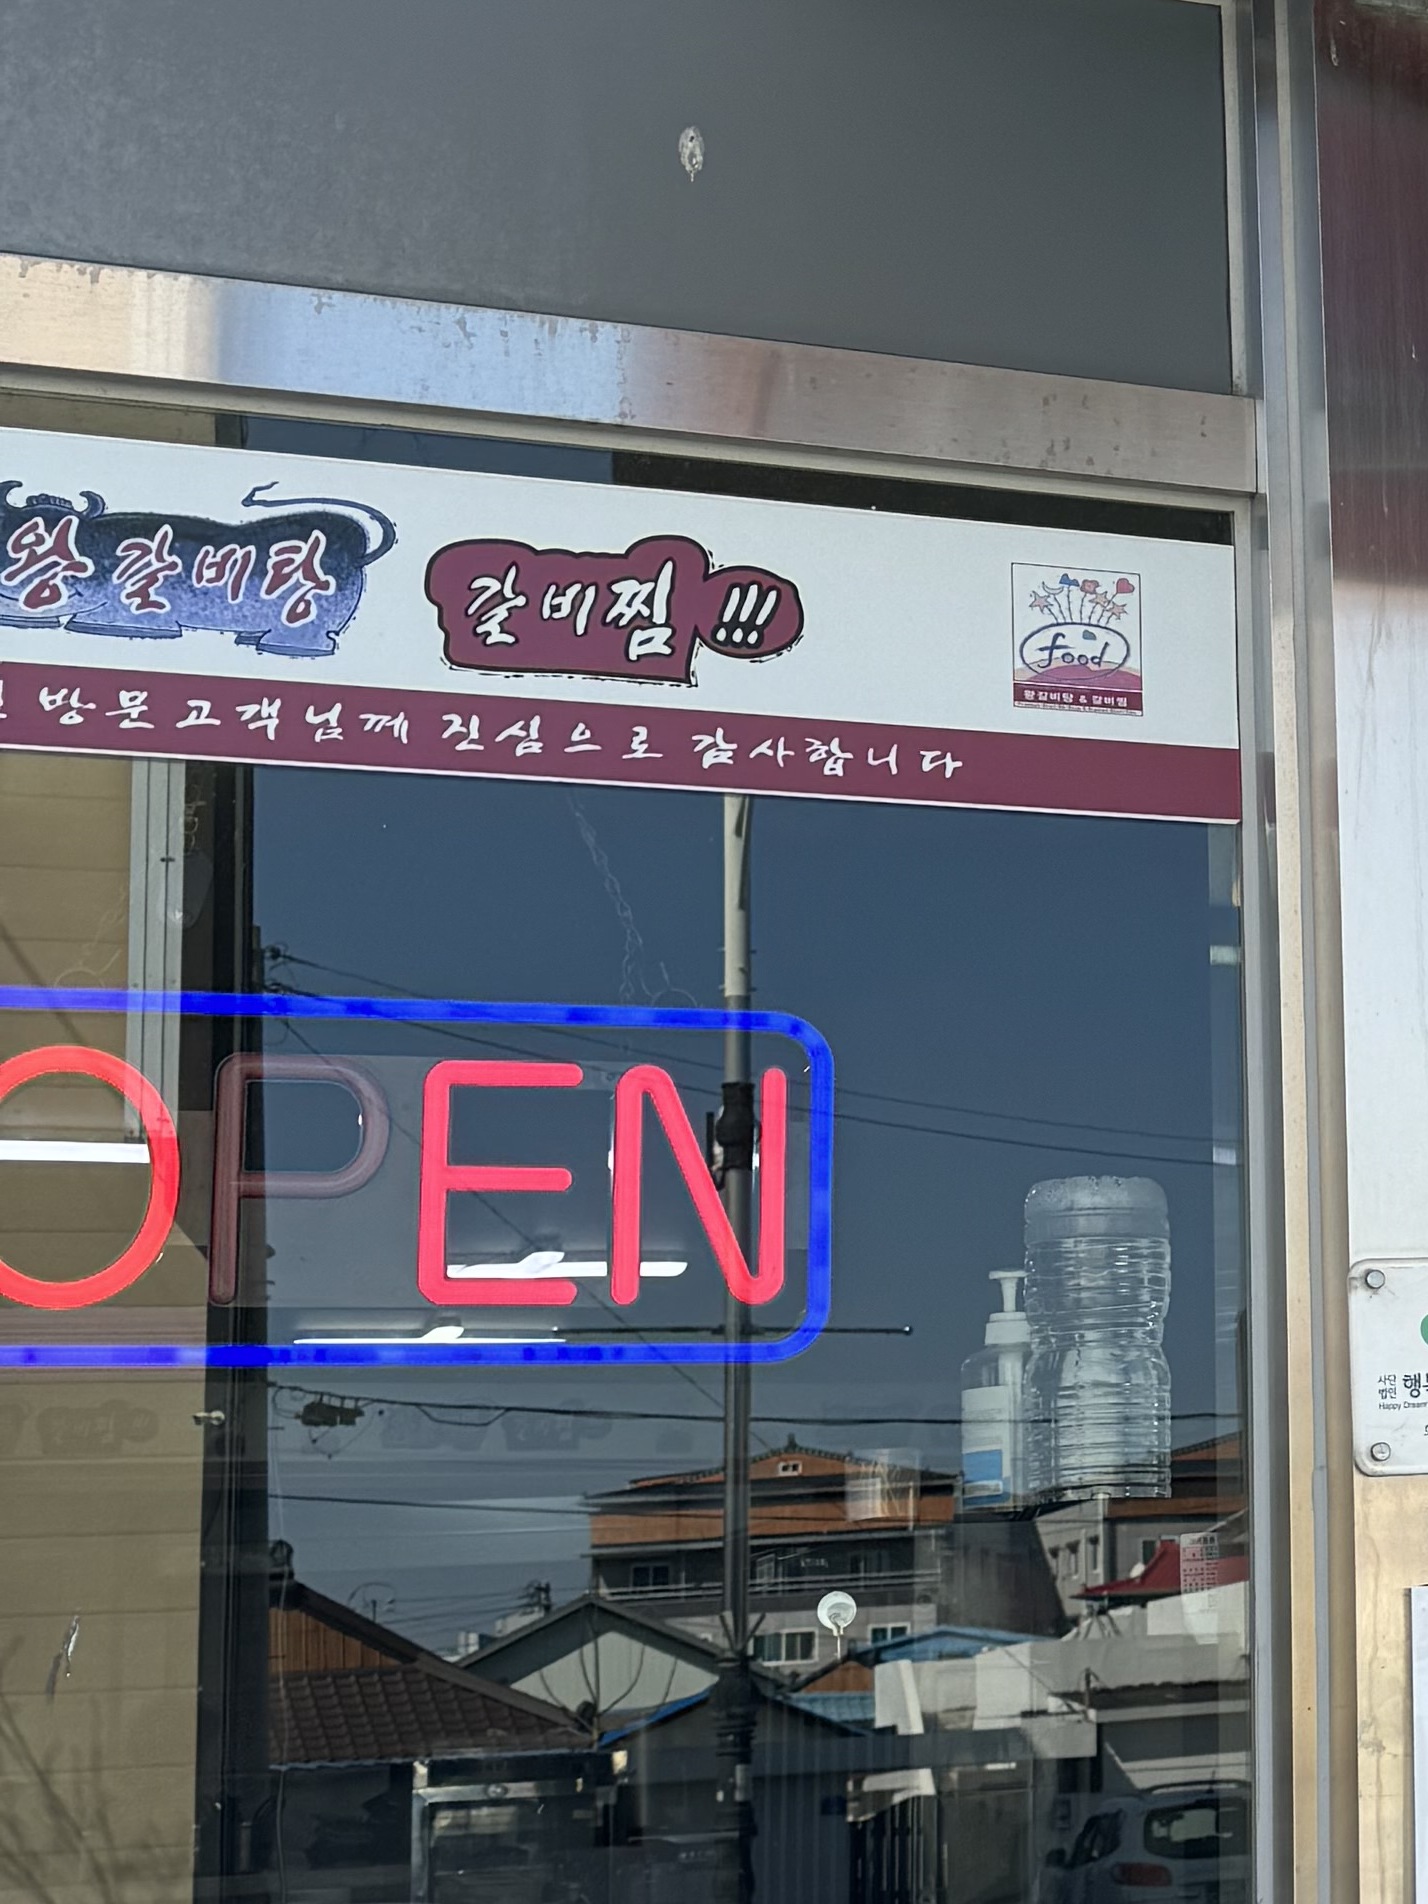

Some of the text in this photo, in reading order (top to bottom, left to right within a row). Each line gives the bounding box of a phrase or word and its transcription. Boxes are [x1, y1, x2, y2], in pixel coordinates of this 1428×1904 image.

[1035, 632, 1110, 668] food
[39, 686, 409, 744] 방문고객님께
[441, 713, 663, 759] 진심으로
[692, 727, 963, 778] 감사합니다
[0, 1046, 787, 1310] OPEN
[1378, 1374, 1396, 1386] 사단
[1378, 1387, 1396, 1399] 법인
